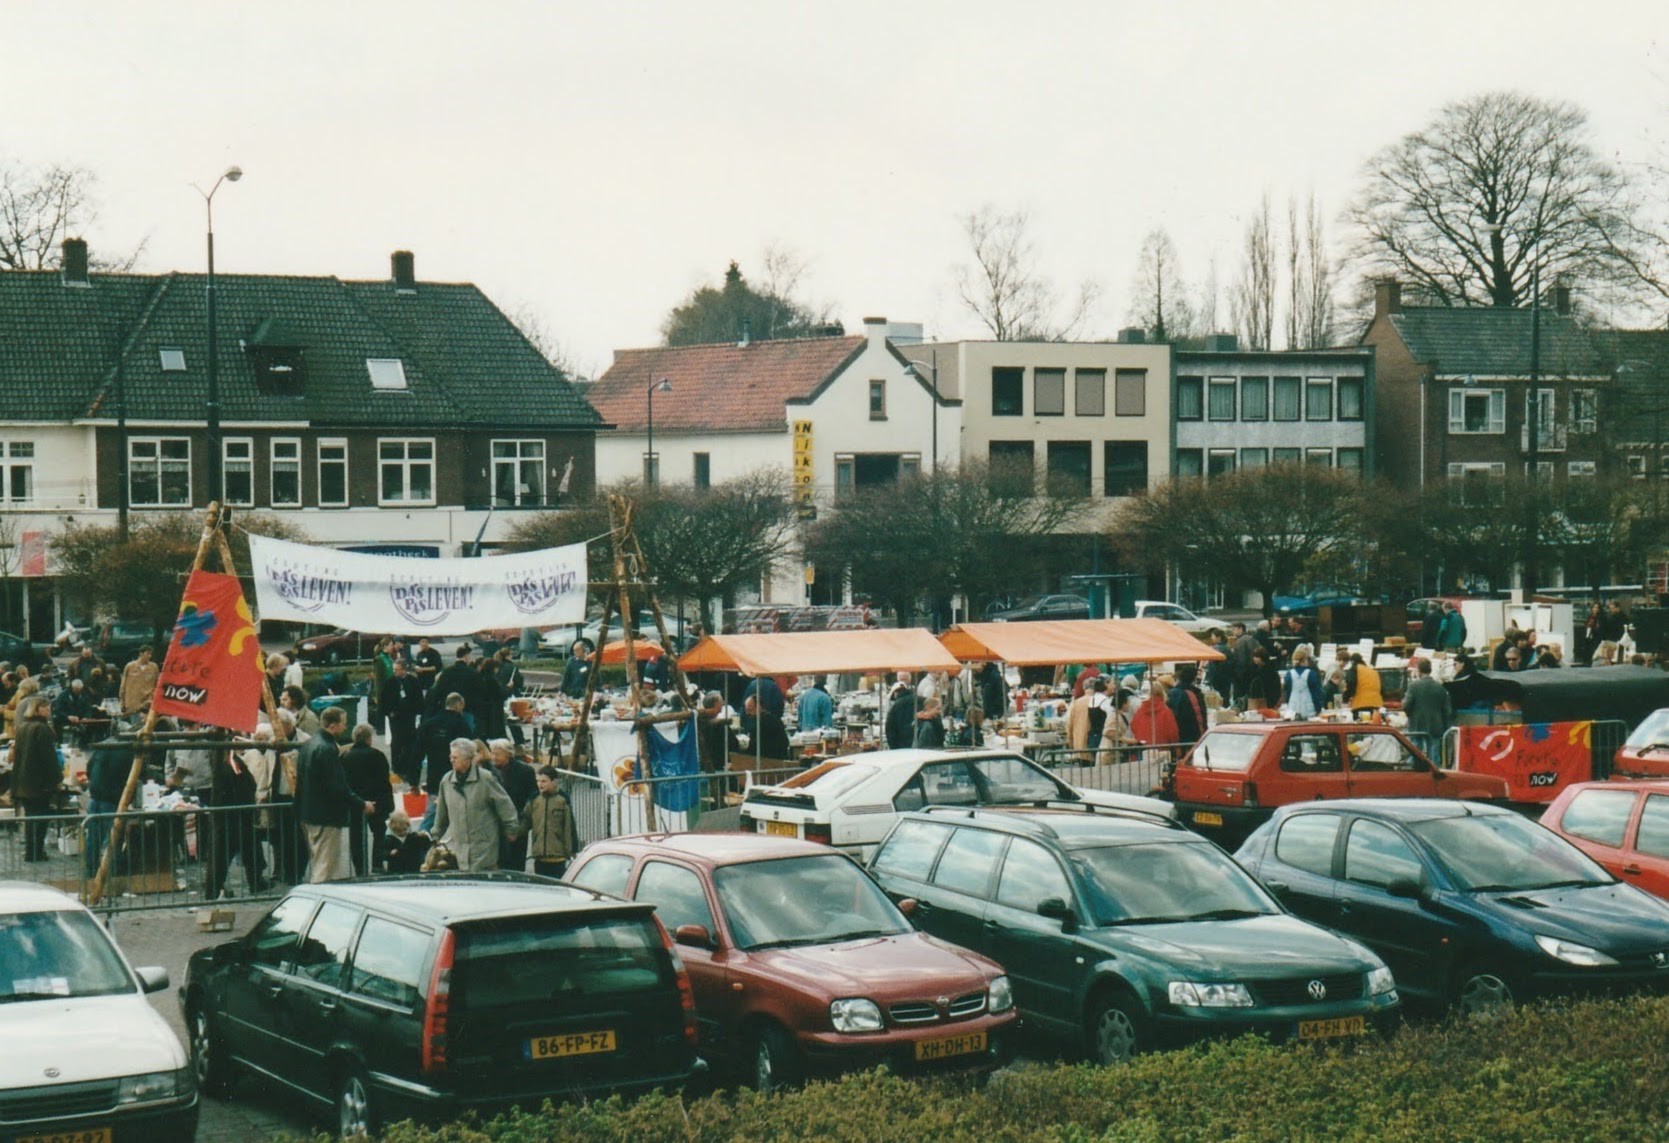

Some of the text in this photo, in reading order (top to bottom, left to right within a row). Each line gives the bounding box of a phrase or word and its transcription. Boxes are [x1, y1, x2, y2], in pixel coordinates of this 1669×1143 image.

[802, 423, 812, 500] Nikon
[301, 575, 353, 606] LEVEN!
[428, 586, 474, 611] LEVEN!
[538, 1032, 608, 1056] 86-FP-FZ
